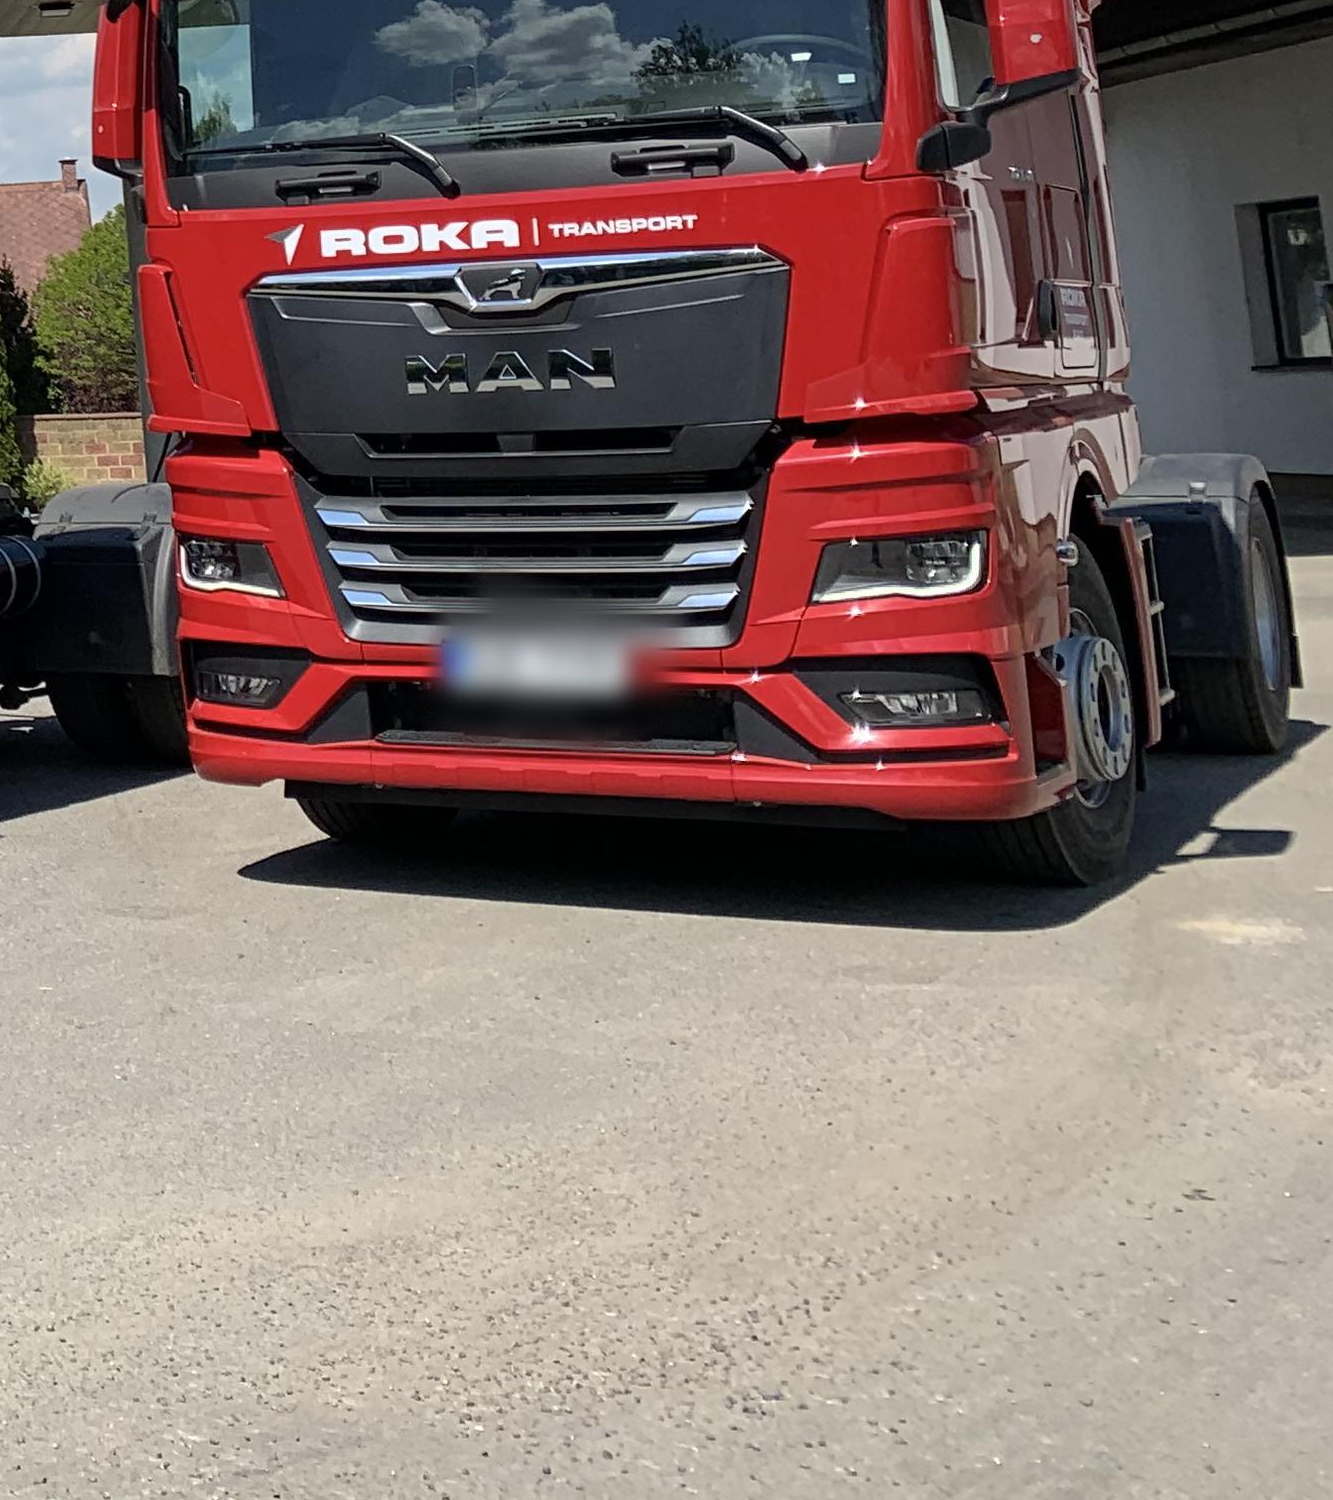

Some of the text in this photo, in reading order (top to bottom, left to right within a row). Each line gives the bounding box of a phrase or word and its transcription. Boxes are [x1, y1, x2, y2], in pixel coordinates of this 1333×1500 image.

[319, 214, 699, 258] ROKA TRANSPORT
[404, 347, 617, 396] MAN
